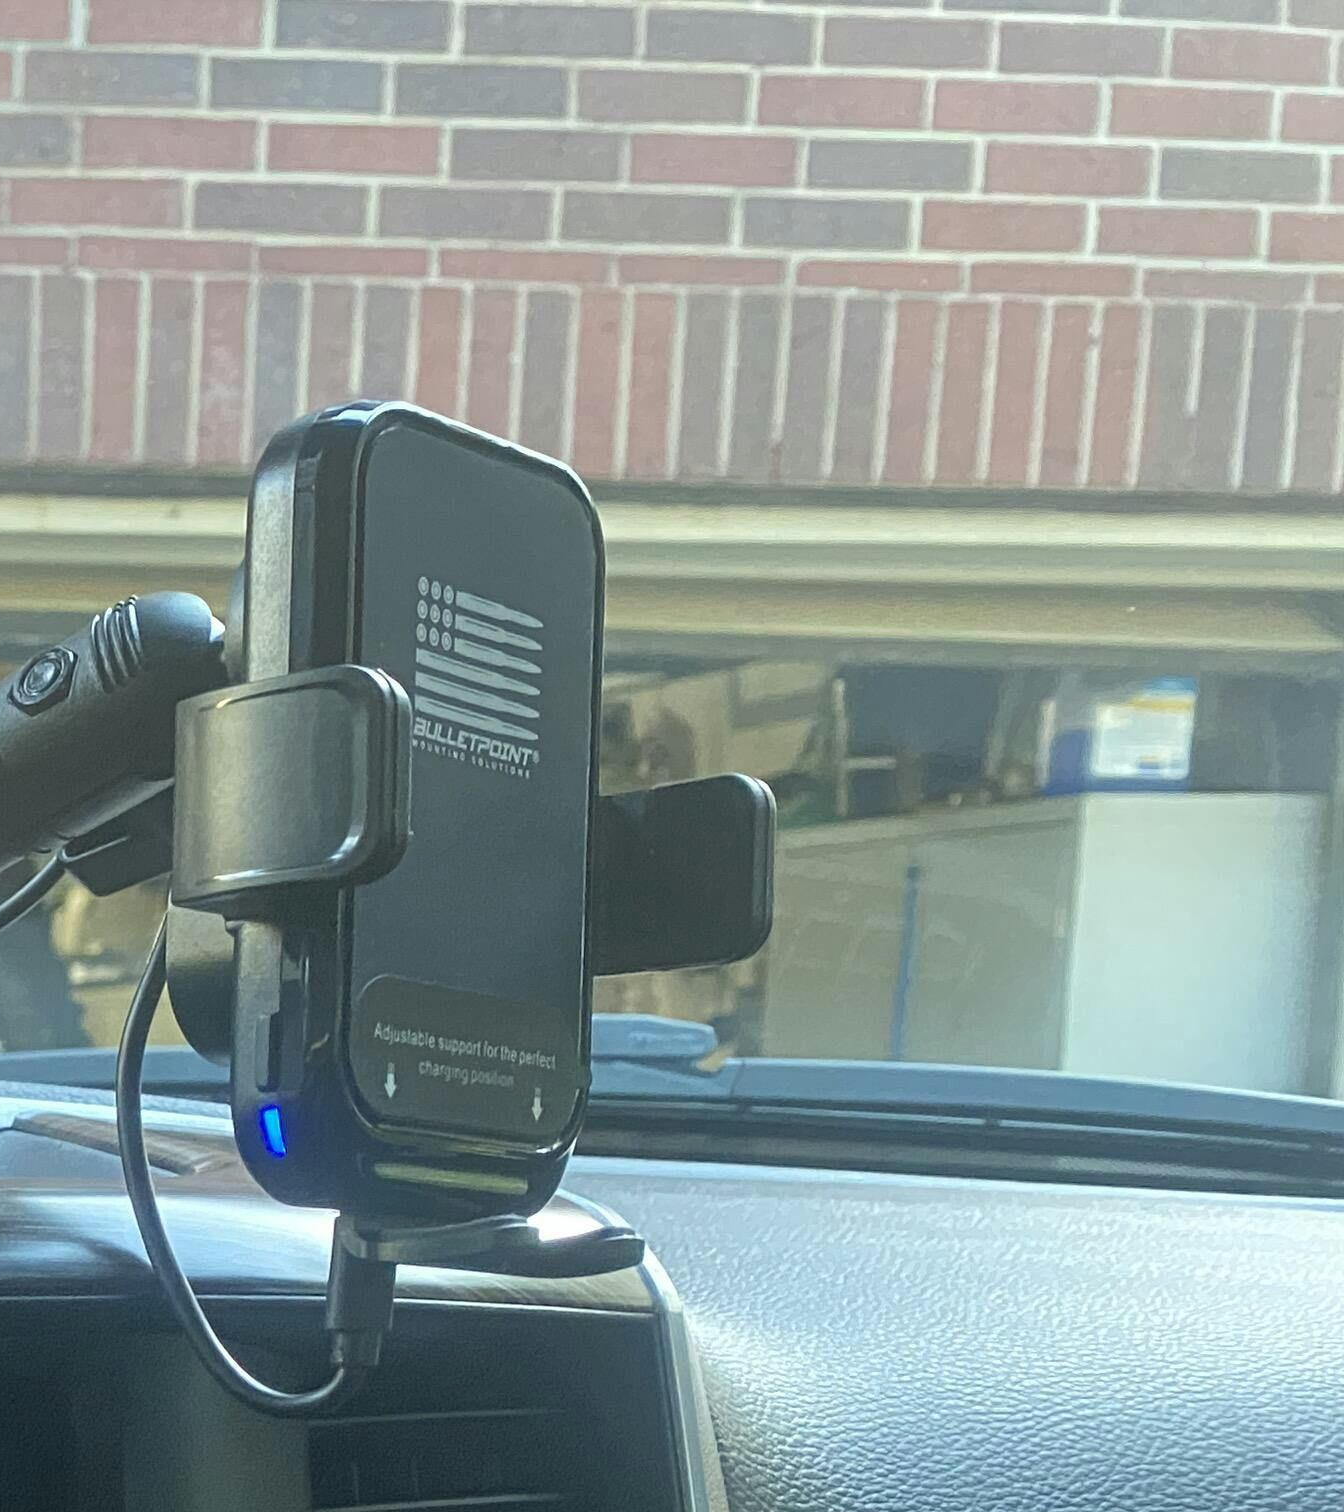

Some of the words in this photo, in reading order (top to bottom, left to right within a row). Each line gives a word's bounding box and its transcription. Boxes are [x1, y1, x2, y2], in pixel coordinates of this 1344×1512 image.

[373, 1021, 436, 1049] Adjustable
[438, 1036, 482, 1057] support
[483, 1042, 500, 1059] for
[500, 1044, 517, 1064] the
[518, 1050, 557, 1071] perfect
[418, 1059, 468, 1086] charging
[470, 1069, 515, 1089] position
